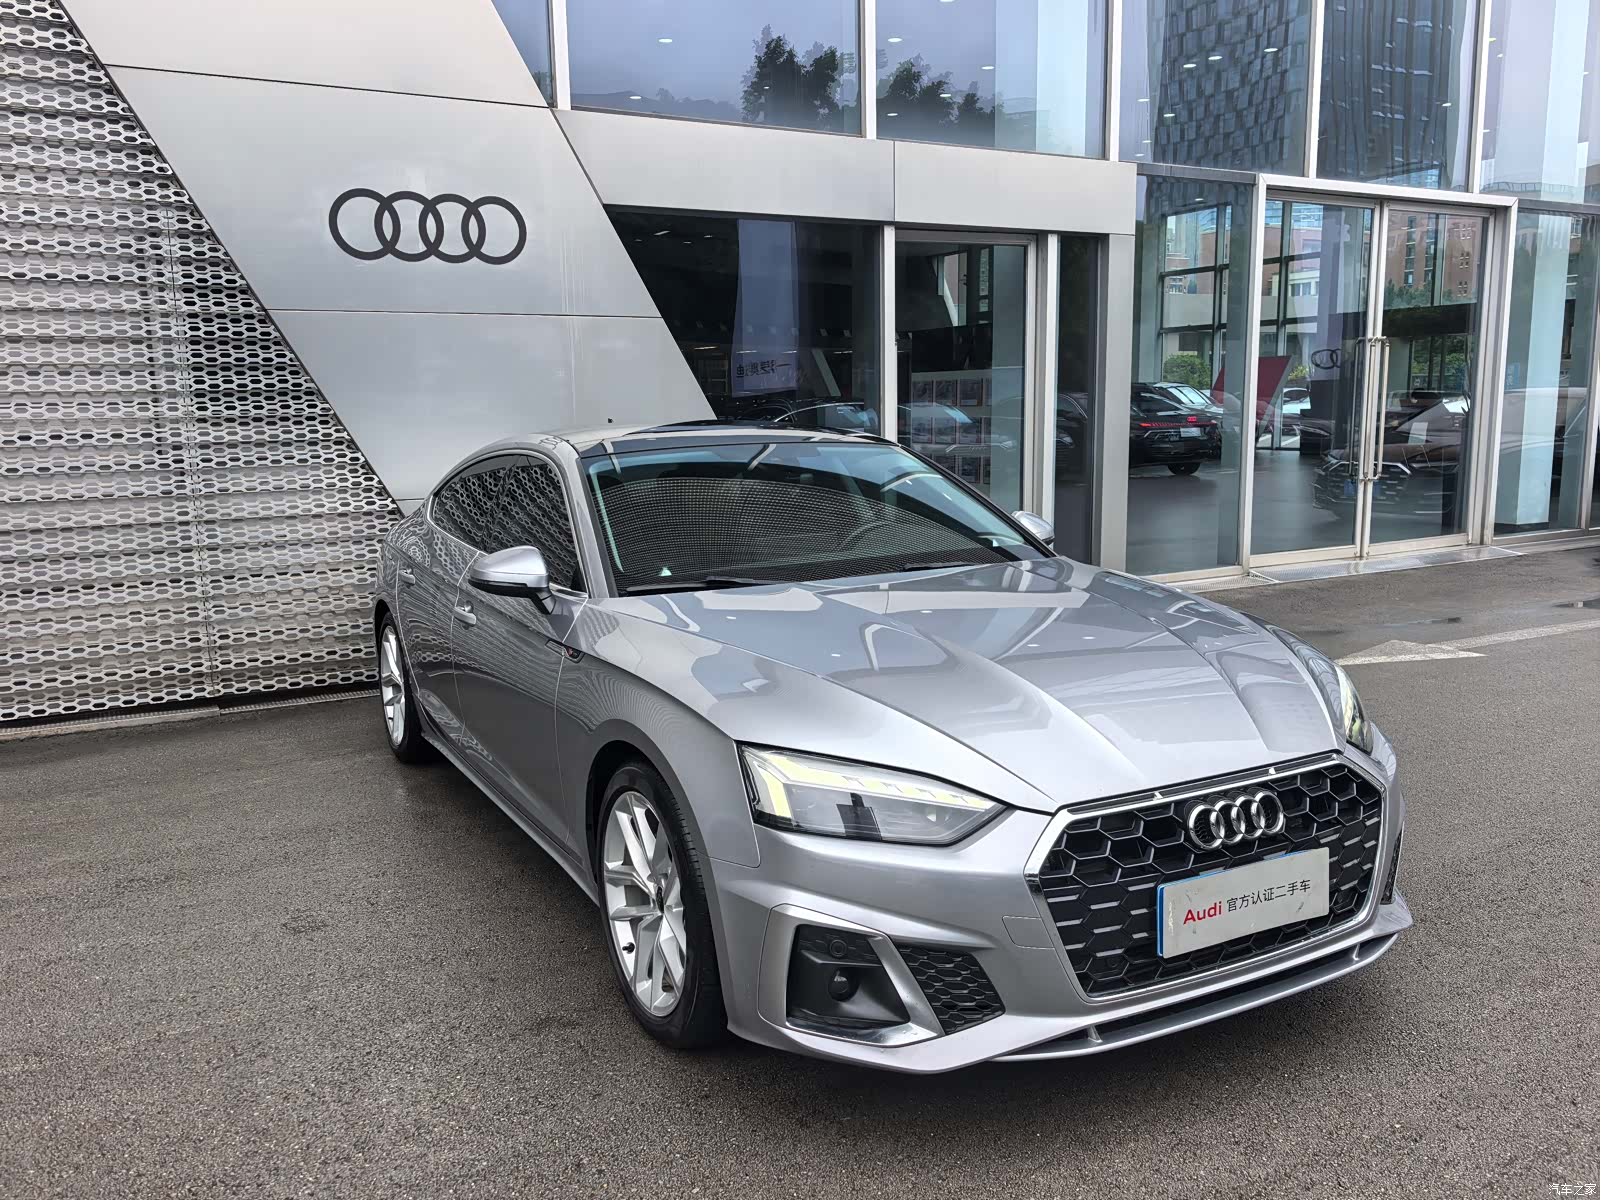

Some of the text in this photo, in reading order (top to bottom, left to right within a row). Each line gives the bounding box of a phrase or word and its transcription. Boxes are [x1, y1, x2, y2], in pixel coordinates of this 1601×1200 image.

[1183, 879, 1311, 925] Audi 官方认证二手车
